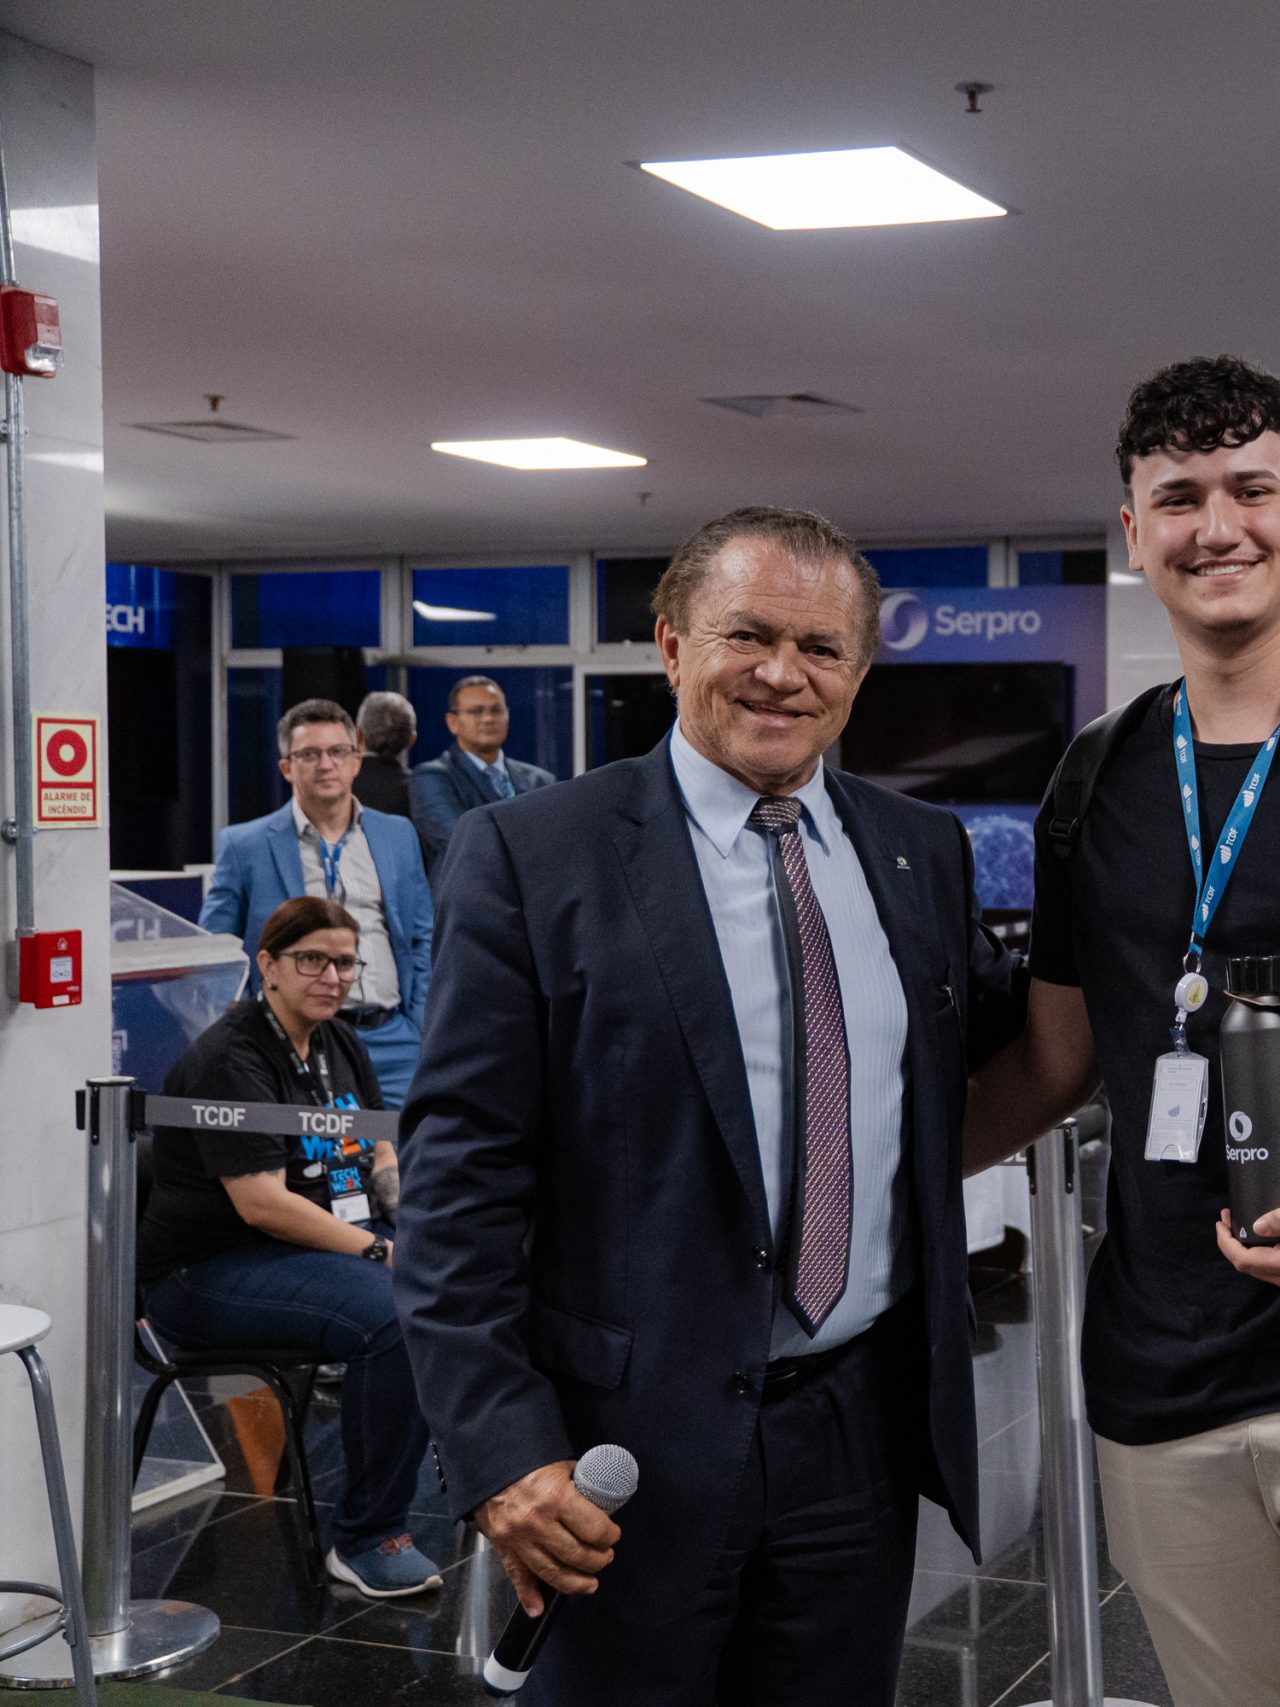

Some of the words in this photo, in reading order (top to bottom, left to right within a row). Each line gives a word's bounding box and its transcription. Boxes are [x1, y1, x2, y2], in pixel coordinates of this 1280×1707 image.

[935, 605, 1041, 640] Serpro
[1249, 773, 1261, 790] TCDF
[44, 792, 77, 801] ALARME
[80, 792, 91, 801] DE
[48, 803, 87, 814] INCÊNDIO
[1226, 827, 1239, 846] TCDF
[1205, 885, 1215, 904] TCDF
[192, 1105, 246, 1127] TCDF
[299, 1112, 354, 1134] TCDF
[1226, 1144, 1269, 1164] Serpro
[330, 1167, 358, 1182] TECH
[331, 1177, 362, 1193] WEEK
